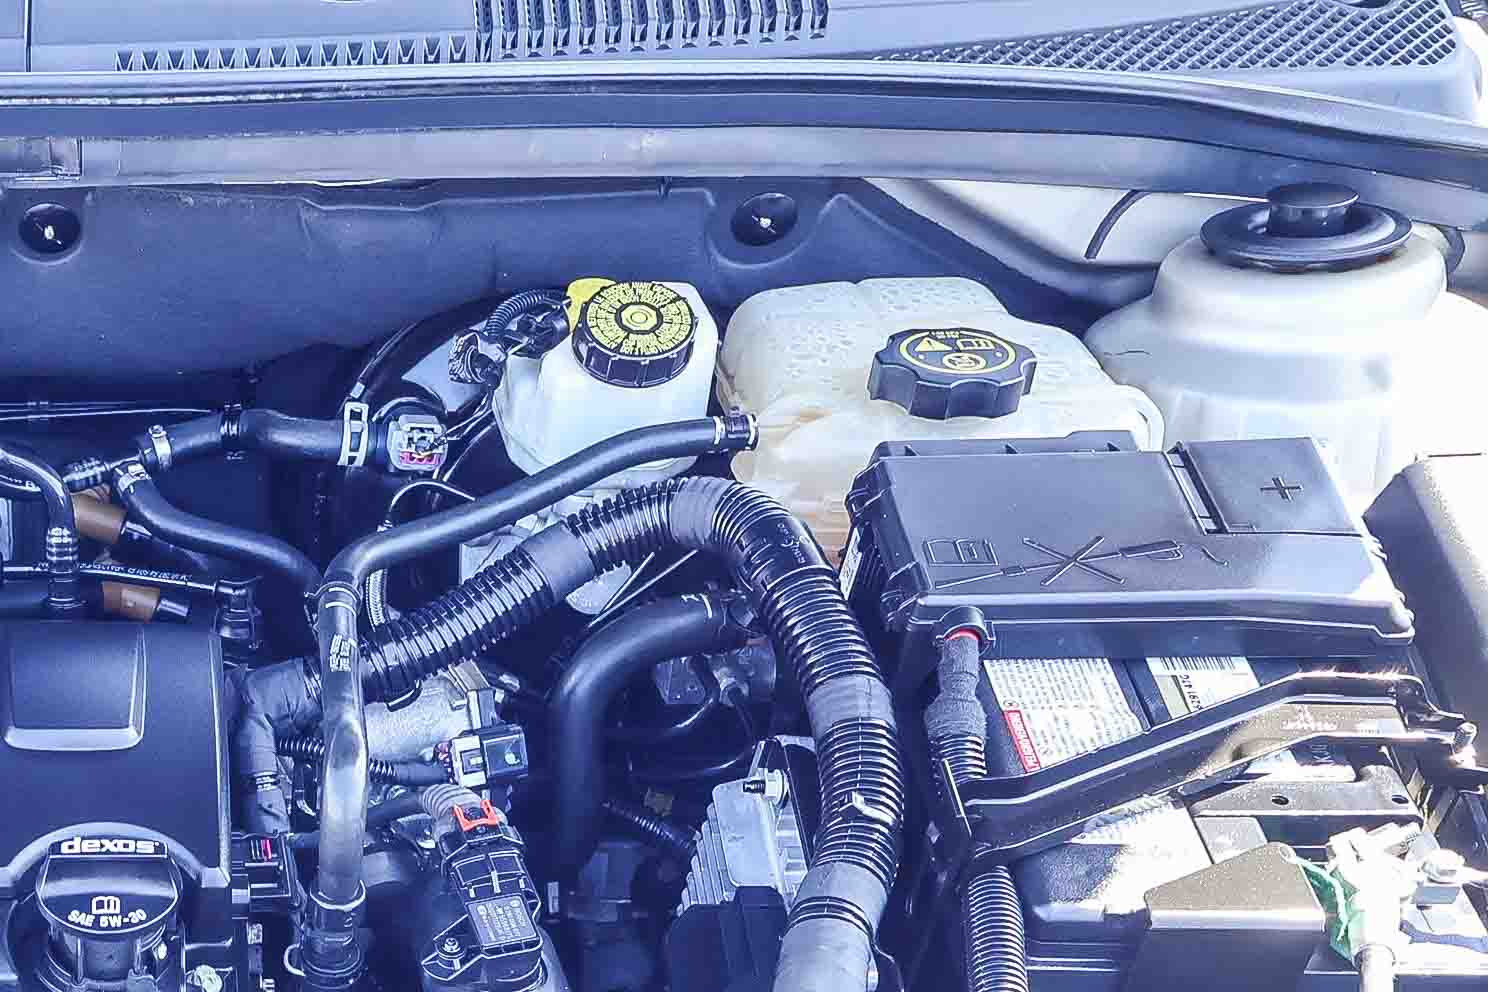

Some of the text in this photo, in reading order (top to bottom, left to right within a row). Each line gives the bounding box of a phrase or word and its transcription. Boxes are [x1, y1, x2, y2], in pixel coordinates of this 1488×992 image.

[60, 836, 157, 854] dexos
[67, 908, 148, 929] SAE 5W-30
